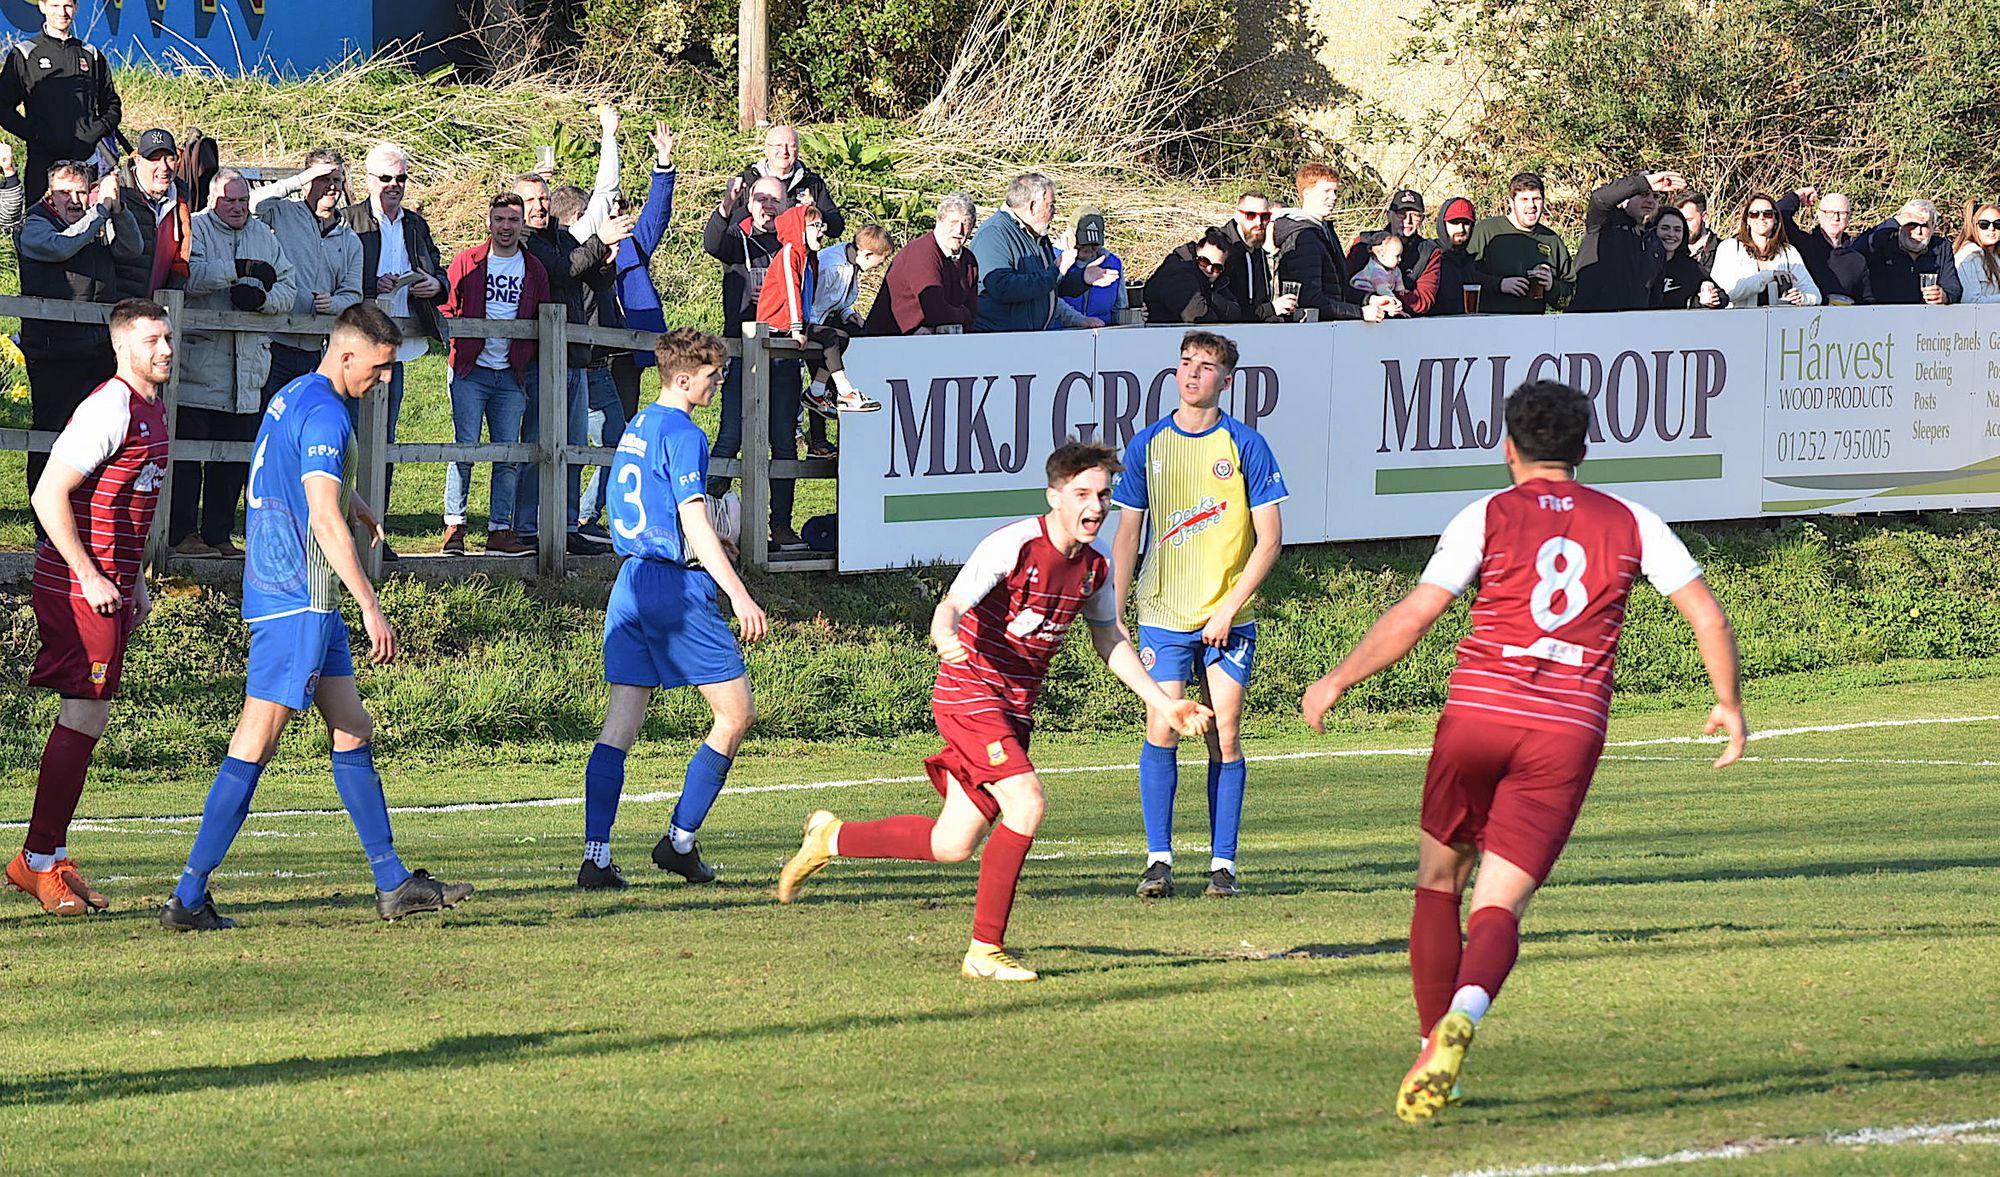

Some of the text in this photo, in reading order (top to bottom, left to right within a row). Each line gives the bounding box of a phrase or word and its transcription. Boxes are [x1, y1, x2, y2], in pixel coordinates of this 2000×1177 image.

[486, 273, 525, 291] ACK
[486, 287, 523, 304] ONE
[1780, 328, 1895, 381] Harvest
[1916, 330, 1981, 357] Fencing Panels
[1915, 360, 1953, 387] Decking
[1376, 355, 1511, 452] MKJ
[1780, 385, 1893, 410] WOOD PRODUCTS
[1914, 391, 1937, 410] Posts
[884, 366, 1279, 478] MKJ GRP
[1912, 419, 1950, 445] Sleepers
[1778, 429, 1890, 462] 01252 795005
[614, 463, 647, 539] 3
[1166, 496, 1215, 534] Deeks
[1172, 513, 1221, 547] Steere
[1530, 536, 1589, 633] 8
